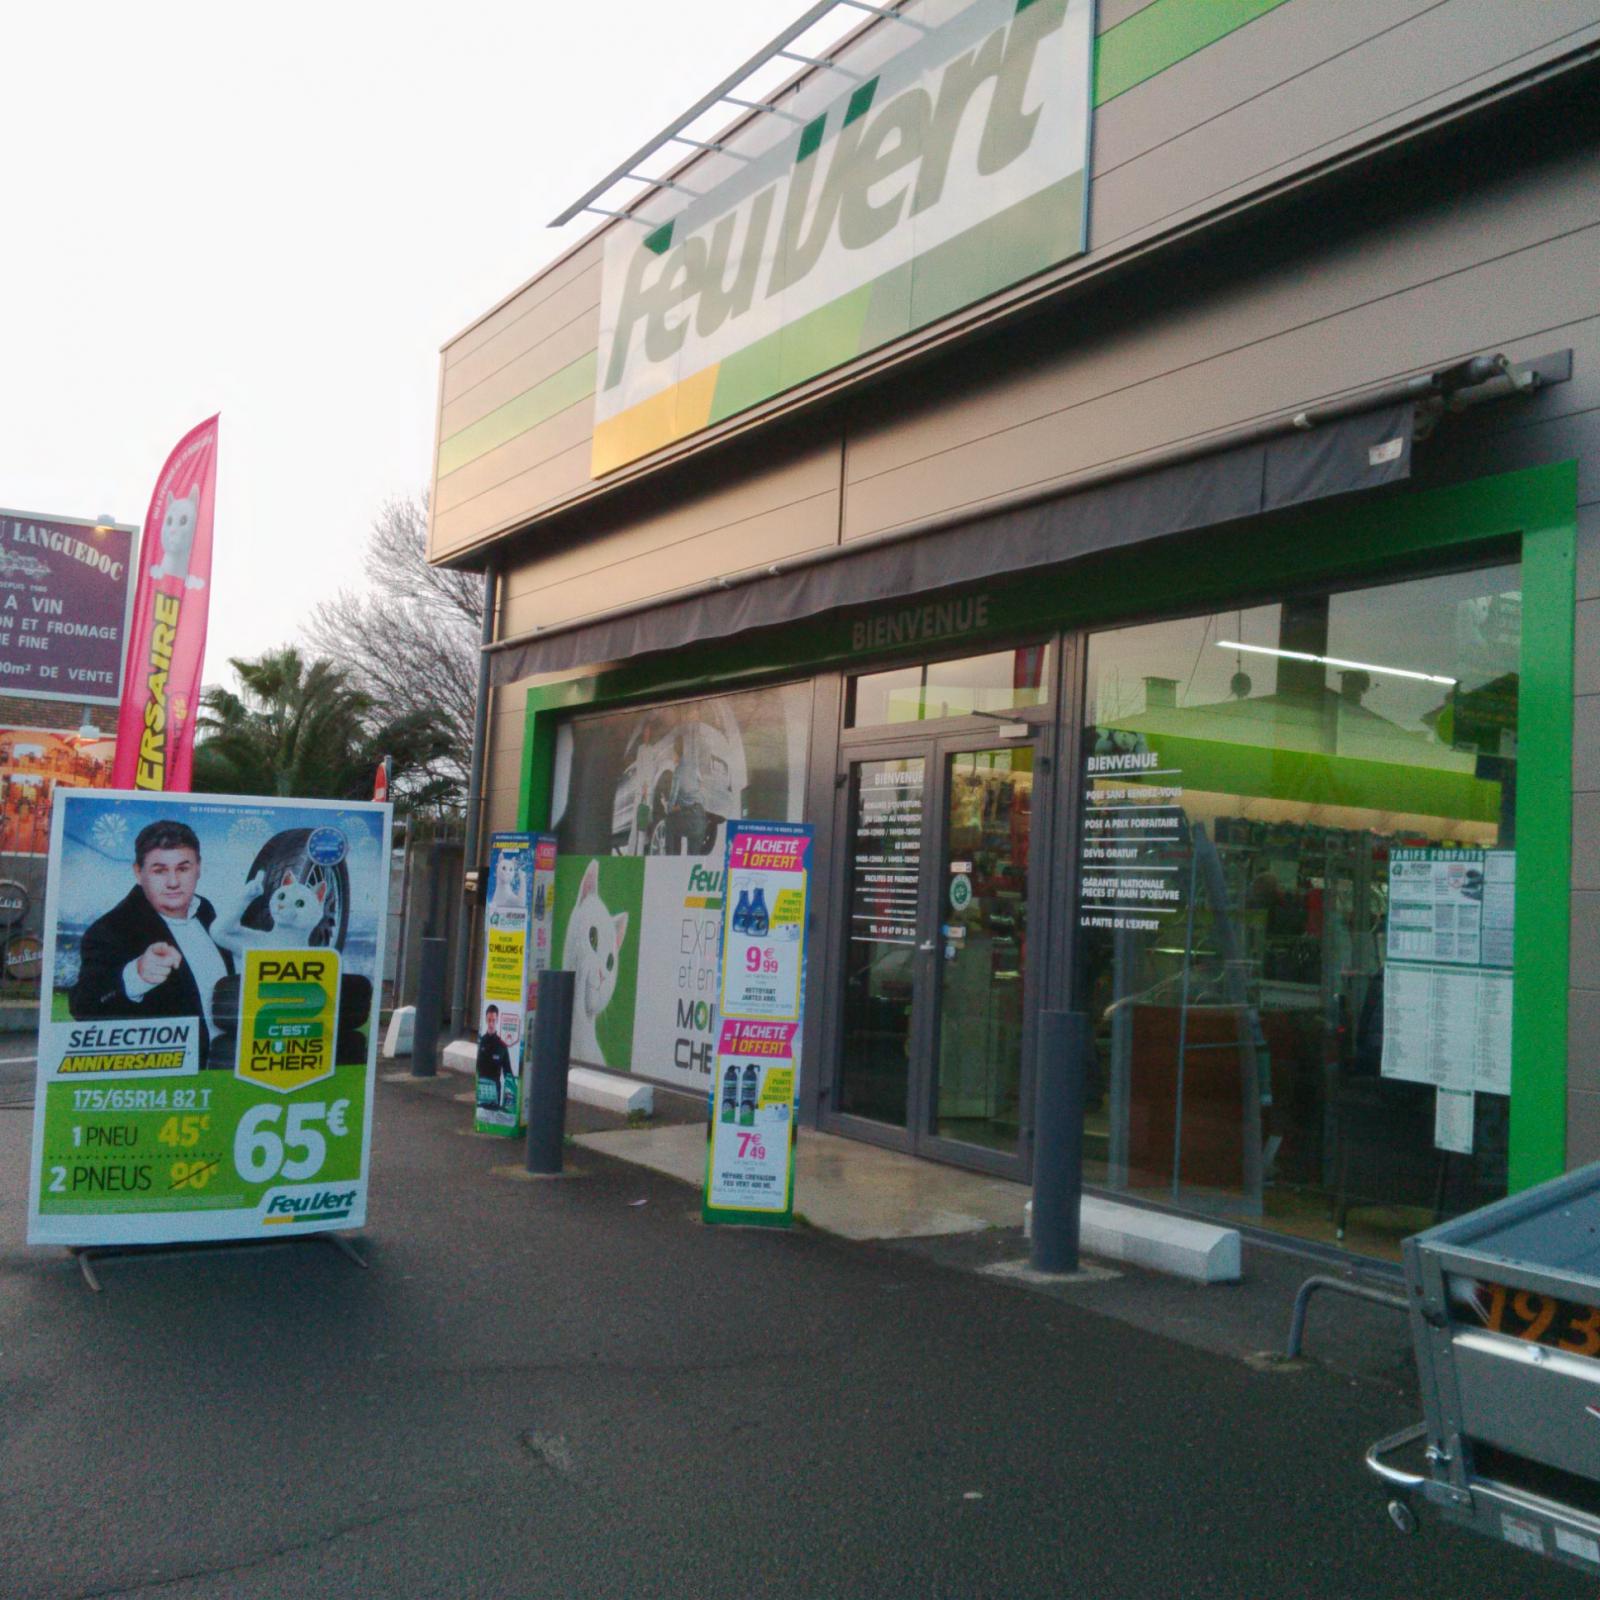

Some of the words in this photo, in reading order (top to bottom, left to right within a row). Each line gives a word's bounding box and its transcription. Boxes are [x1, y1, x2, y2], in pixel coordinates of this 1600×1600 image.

[13, 522, 124, 581] LANGUEDOC
[4, 594, 18, 611] A
[31, 596, 63, 615] VIN
[21, 618, 39, 632] ET
[46, 621, 118, 641] FROMAGE
[852, 595, 990, 650] BIENVENUE
[17, 636, 50, 651] FINE
[39, 664, 59, 679] DE
[67, 667, 114, 684] VENTE
[1087, 752, 1159, 772] BIENVENUE
[874, 770, 925, 786] BIENVENUE
[1085, 820, 1103, 829] POSE
[1104, 820, 1110, 828] A
[1112, 819, 1129, 829] PRIX
[1130, 818, 1179, 828] FORFAITAIRE
[746, 837, 752, 852] 1
[753, 838, 800, 855] ACHETÉ
[1083, 849, 1105, 859] DEVIS
[1106, 849, 1138, 859] GRATUIT
[742, 853, 749, 867] 1
[750, 854, 798, 869] OFFERT
[1390, 850, 1427, 861] TARIFS
[1431, 850, 1485, 862] FORFAITS
[1082, 878, 1119, 889] GARANTIE
[1120, 879, 1165, 890] NATIONALE
[1107, 888, 1116, 898] ET
[1117, 889, 1138, 899] MAIN
[1140, 889, 1180, 901] D'OEUVRE
[1081, 917, 1091, 927] LA
[1091, 917, 1113, 928] PATTE
[1113, 918, 1124, 928] DE
[1125, 919, 1160, 930] L'EXPERT
[258, 961, 325, 981] PAR
[678, 965, 692, 989] et
[69, 1025, 189, 1048] SÉLECTION
[267, 1025, 310, 1037] C'EST
[734, 1024, 740, 1038] 1
[741, 1025, 788, 1040] ACHETÉ
[252, 1039, 324, 1056] MOINS
[731, 1039, 737, 1052] 1
[738, 1040, 786, 1055] OFFERT
[57, 1050, 186, 1074] ANNIVERSAIRE
[250, 1055, 324, 1072] CHER!
[73, 1089, 168, 1110] 175/65R14
[172, 1089, 197, 1109] 82
[200, 1088, 212, 1108] T
[72, 1126, 81, 1147] 1
[85, 1126, 139, 1147] PNEU
[158, 1115, 211, 1148] 45€
[233, 1098, 351, 1184] 65€
[49, 1166, 67, 1193] 2
[72, 1165, 152, 1192] PNEUS
